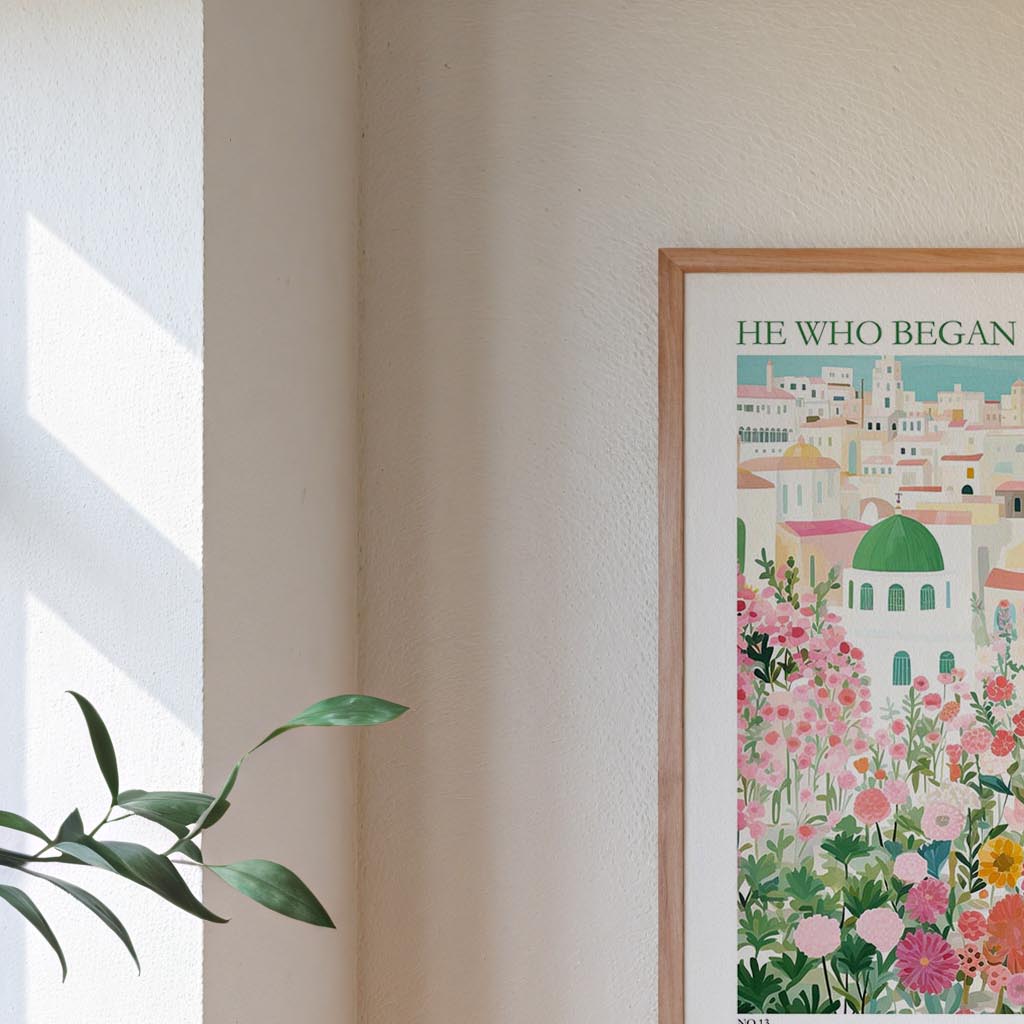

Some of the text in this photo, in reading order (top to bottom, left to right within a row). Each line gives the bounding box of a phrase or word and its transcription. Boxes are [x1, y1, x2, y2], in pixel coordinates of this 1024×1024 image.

[737, 321, 786, 345] HE
[795, 321, 882, 346] WHO
[893, 320, 1016, 345] BEGAN
